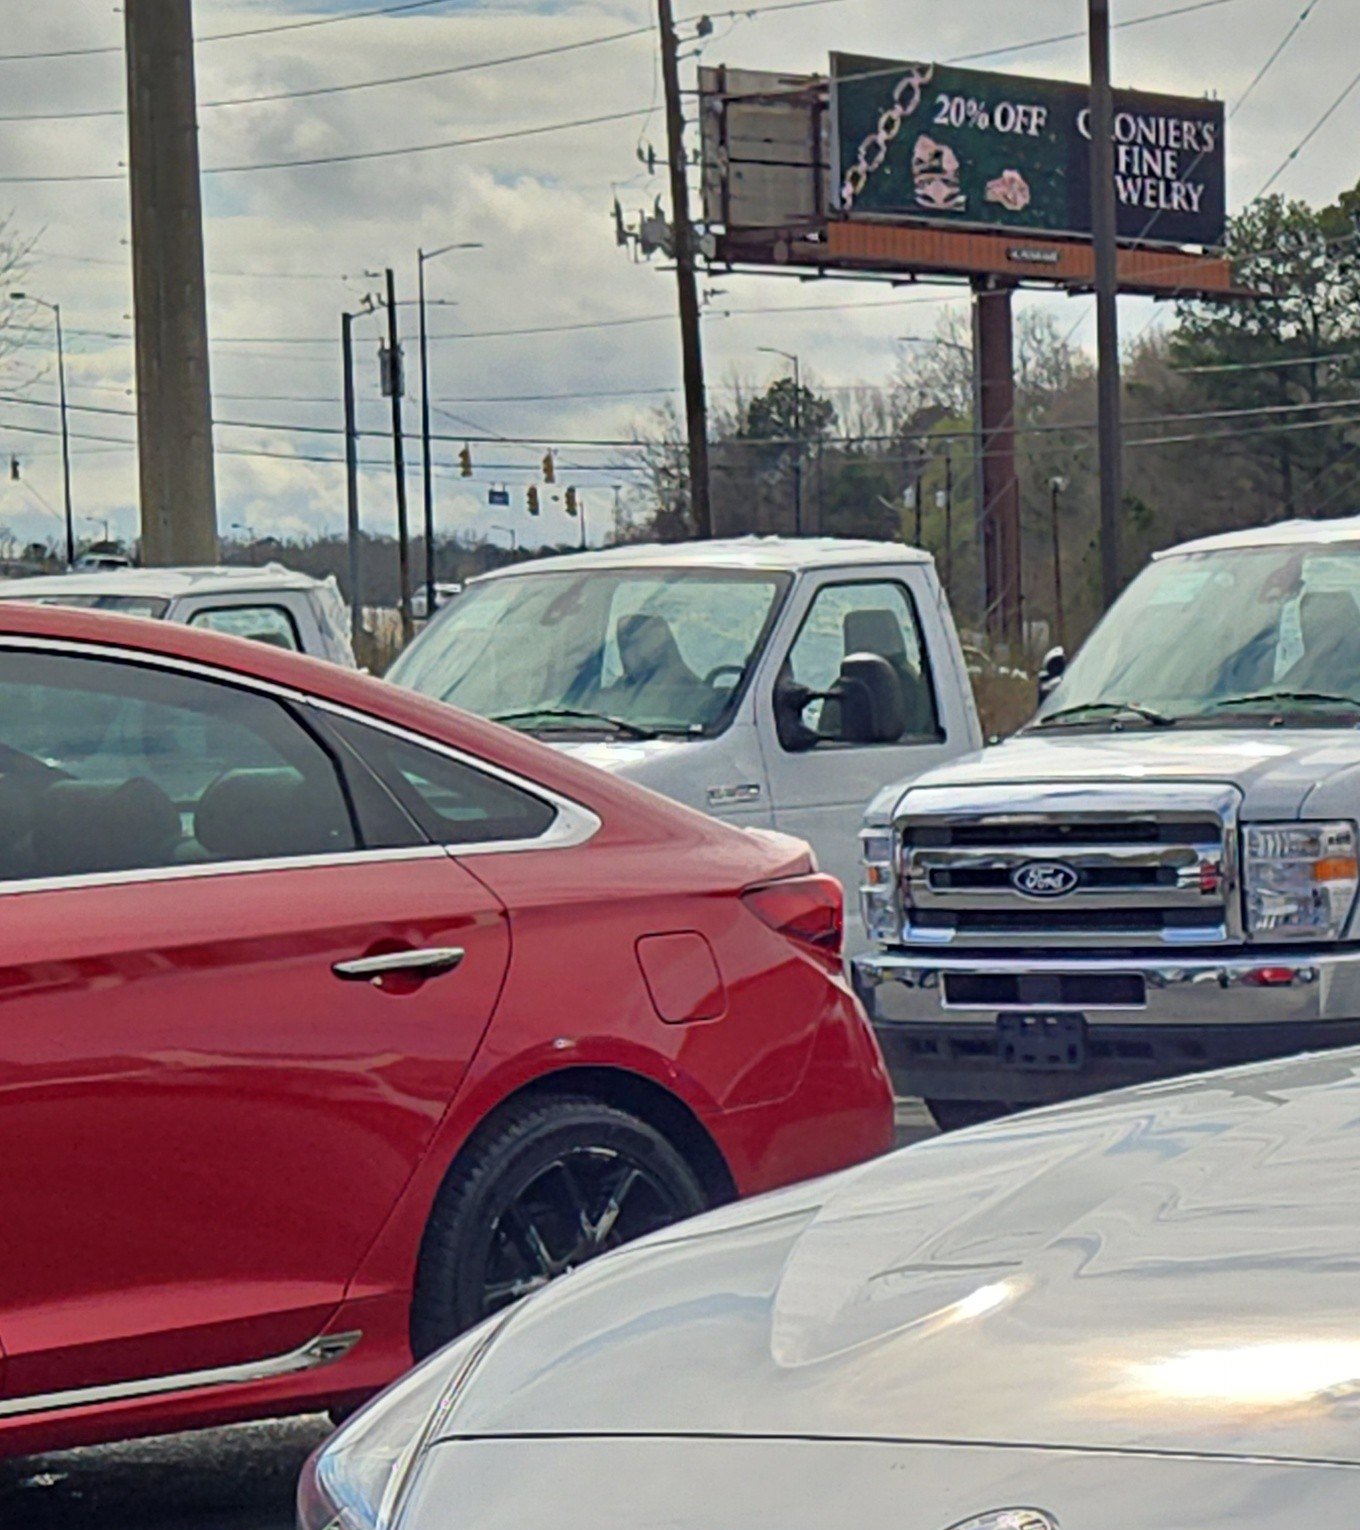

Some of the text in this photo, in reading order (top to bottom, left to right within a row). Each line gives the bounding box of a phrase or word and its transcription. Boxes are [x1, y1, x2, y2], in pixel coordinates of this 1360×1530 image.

[933, 94, 1048, 137] 20% OFF
[1076, 107, 1216, 152] CONIER'S
[1117, 145, 1178, 179] FINE
[1114, 174, 1205, 213] WELRY
[1025, 866, 1065, 890] Ford
